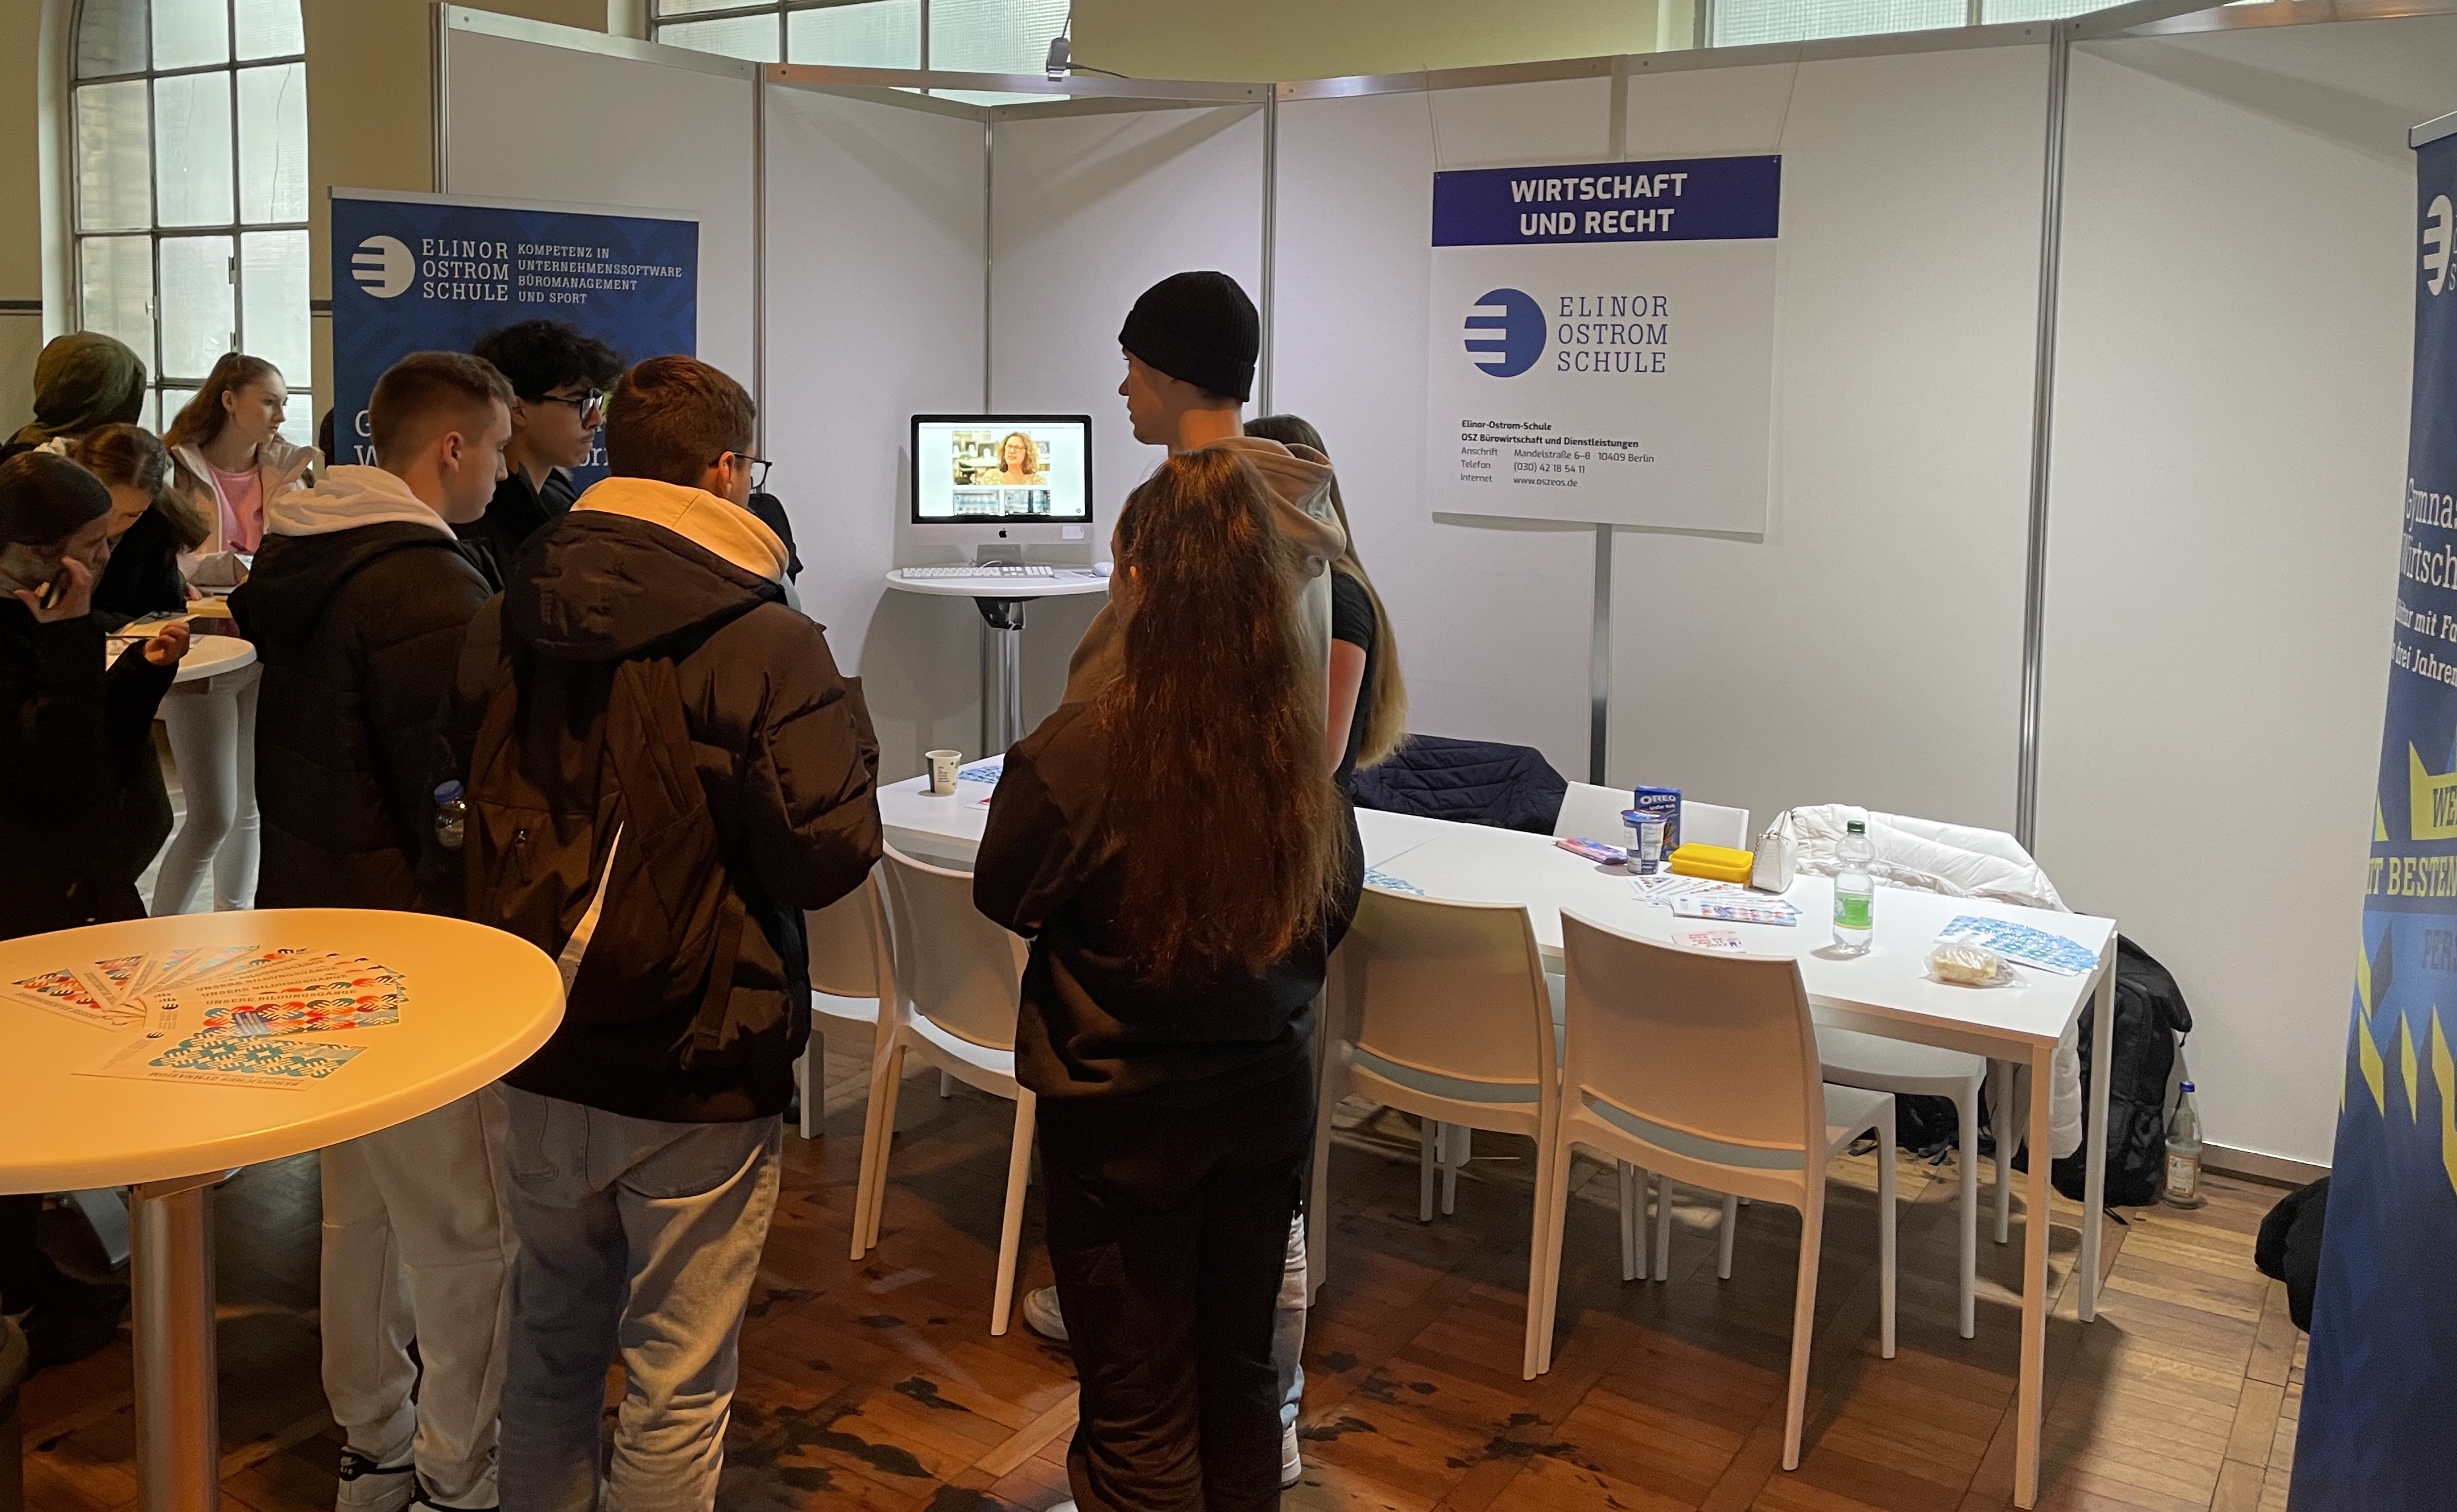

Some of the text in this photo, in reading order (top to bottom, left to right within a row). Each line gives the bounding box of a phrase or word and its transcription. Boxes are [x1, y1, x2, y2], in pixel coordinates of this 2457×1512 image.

[1510, 173, 1688, 202] WIRTSCHAFT
[1520, 208, 1675, 236] UND RECHT
[422, 239, 509, 259] ELINOR
[518, 243, 609, 259] KOMPETENZ IN
[422, 260, 509, 280] OSTROM
[518, 259, 682, 278] UNTERNEHMENSSOFTWARE
[518, 274, 637, 291] BÜROMANAGEMENT
[423, 282, 509, 301] SCHULE
[518, 291, 587, 304] UND SPORT
[1559, 295, 1669, 317] ELINOR
[1558, 323, 1668, 345] OSTROM
[1557, 351, 1666, 373] SCHULE
[1462, 419, 1552, 431] Elinor-Ostrom-Schule
[1461, 433, 1639, 450] OSZ Bürowirtschaft und Dienstleistungen
[1461, 446, 1499, 456] Anschrift
[1514, 449, 1572, 460] Mandelstraße
[1598, 452, 1626, 462] 10409
[1628, 454, 1654, 463] Berlin
[1460, 460, 1491, 469] Telefon
[1514, 462, 1538, 473] (030)
[1540, 463, 1551, 472] 42
[1553, 464, 1562, 473] 18
[1565, 464, 1576, 473] 54
[1460, 473, 1493, 483] Internet
[2414, 610, 2437, 637] mit
[1640, 795, 1677, 805] OREO
[2386, 855, 2457, 897] BESTEN
[258, 989, 358, 1002] BILDUNGSGÄNGE
